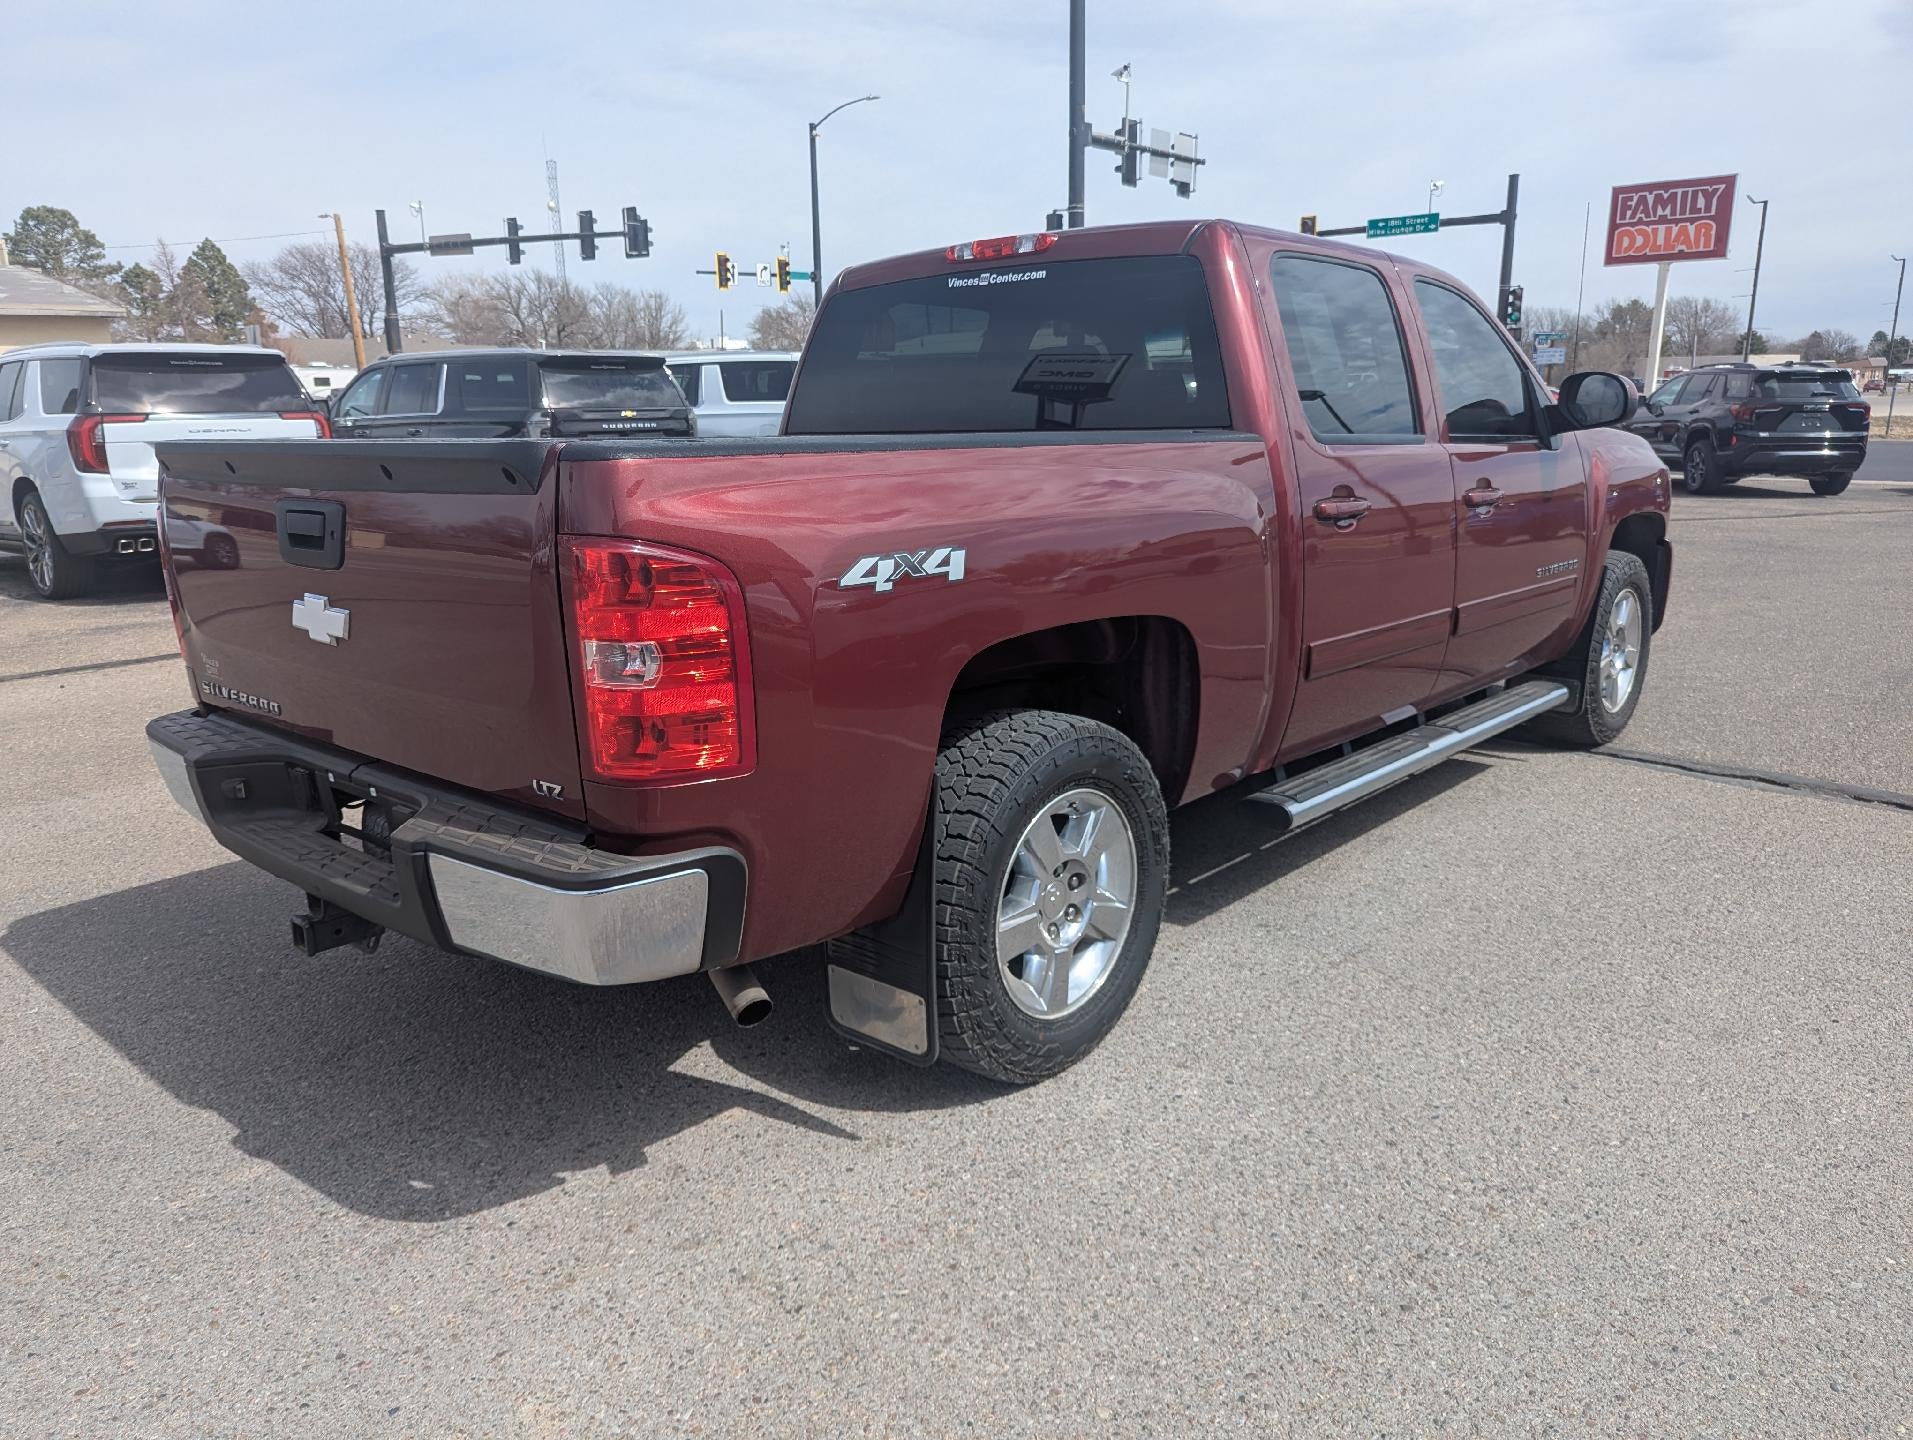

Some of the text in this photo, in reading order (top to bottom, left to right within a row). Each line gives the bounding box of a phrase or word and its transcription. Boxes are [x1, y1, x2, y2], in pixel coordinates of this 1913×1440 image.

[1616, 184, 1726, 223] FAMILY
[1405, 216, 1429, 225] Street
[1415, 224, 1425, 232] Dr
[1612, 220, 1716, 257] DOLLAR
[1536, 559, 1579, 578] SILVERADO
[201, 680, 281, 715] SILVERADO
[532, 779, 564, 801] LTZ
